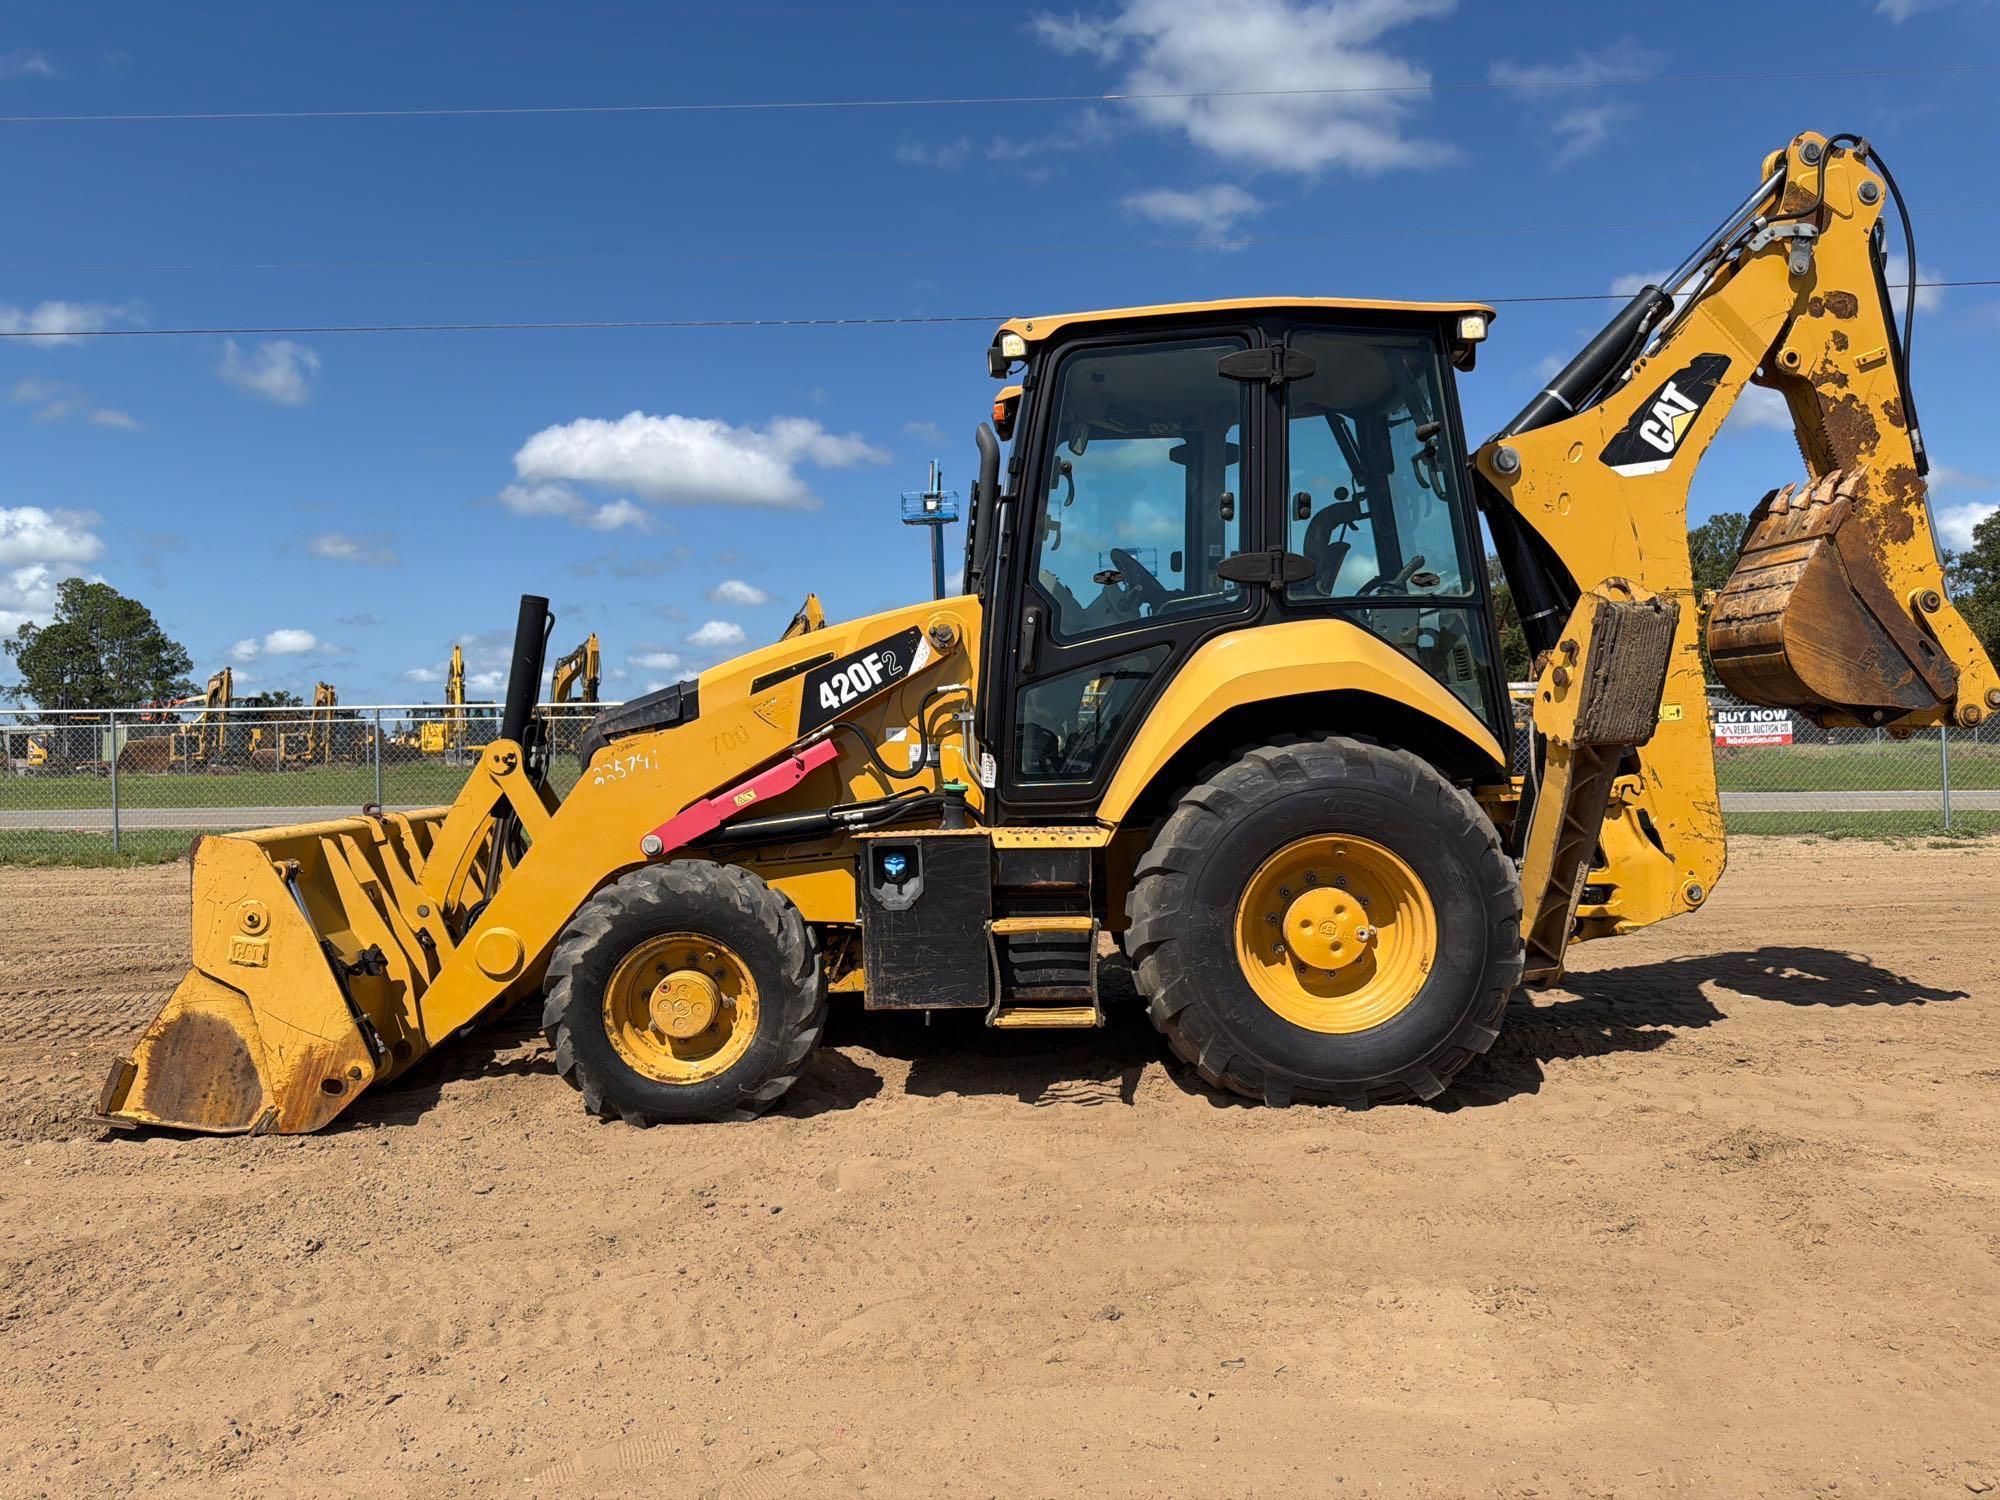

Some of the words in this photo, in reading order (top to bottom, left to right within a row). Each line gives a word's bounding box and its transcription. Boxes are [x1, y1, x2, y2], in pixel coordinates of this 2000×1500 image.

[1640, 381, 1699, 453] CAT
[819, 650, 903, 710] 420F2
[1718, 711, 1747, 723] BUY
[1750, 709, 1788, 722] NOW
[1733, 725, 1752, 735] REBEL
[1753, 723, 1779, 735] AUCTION
